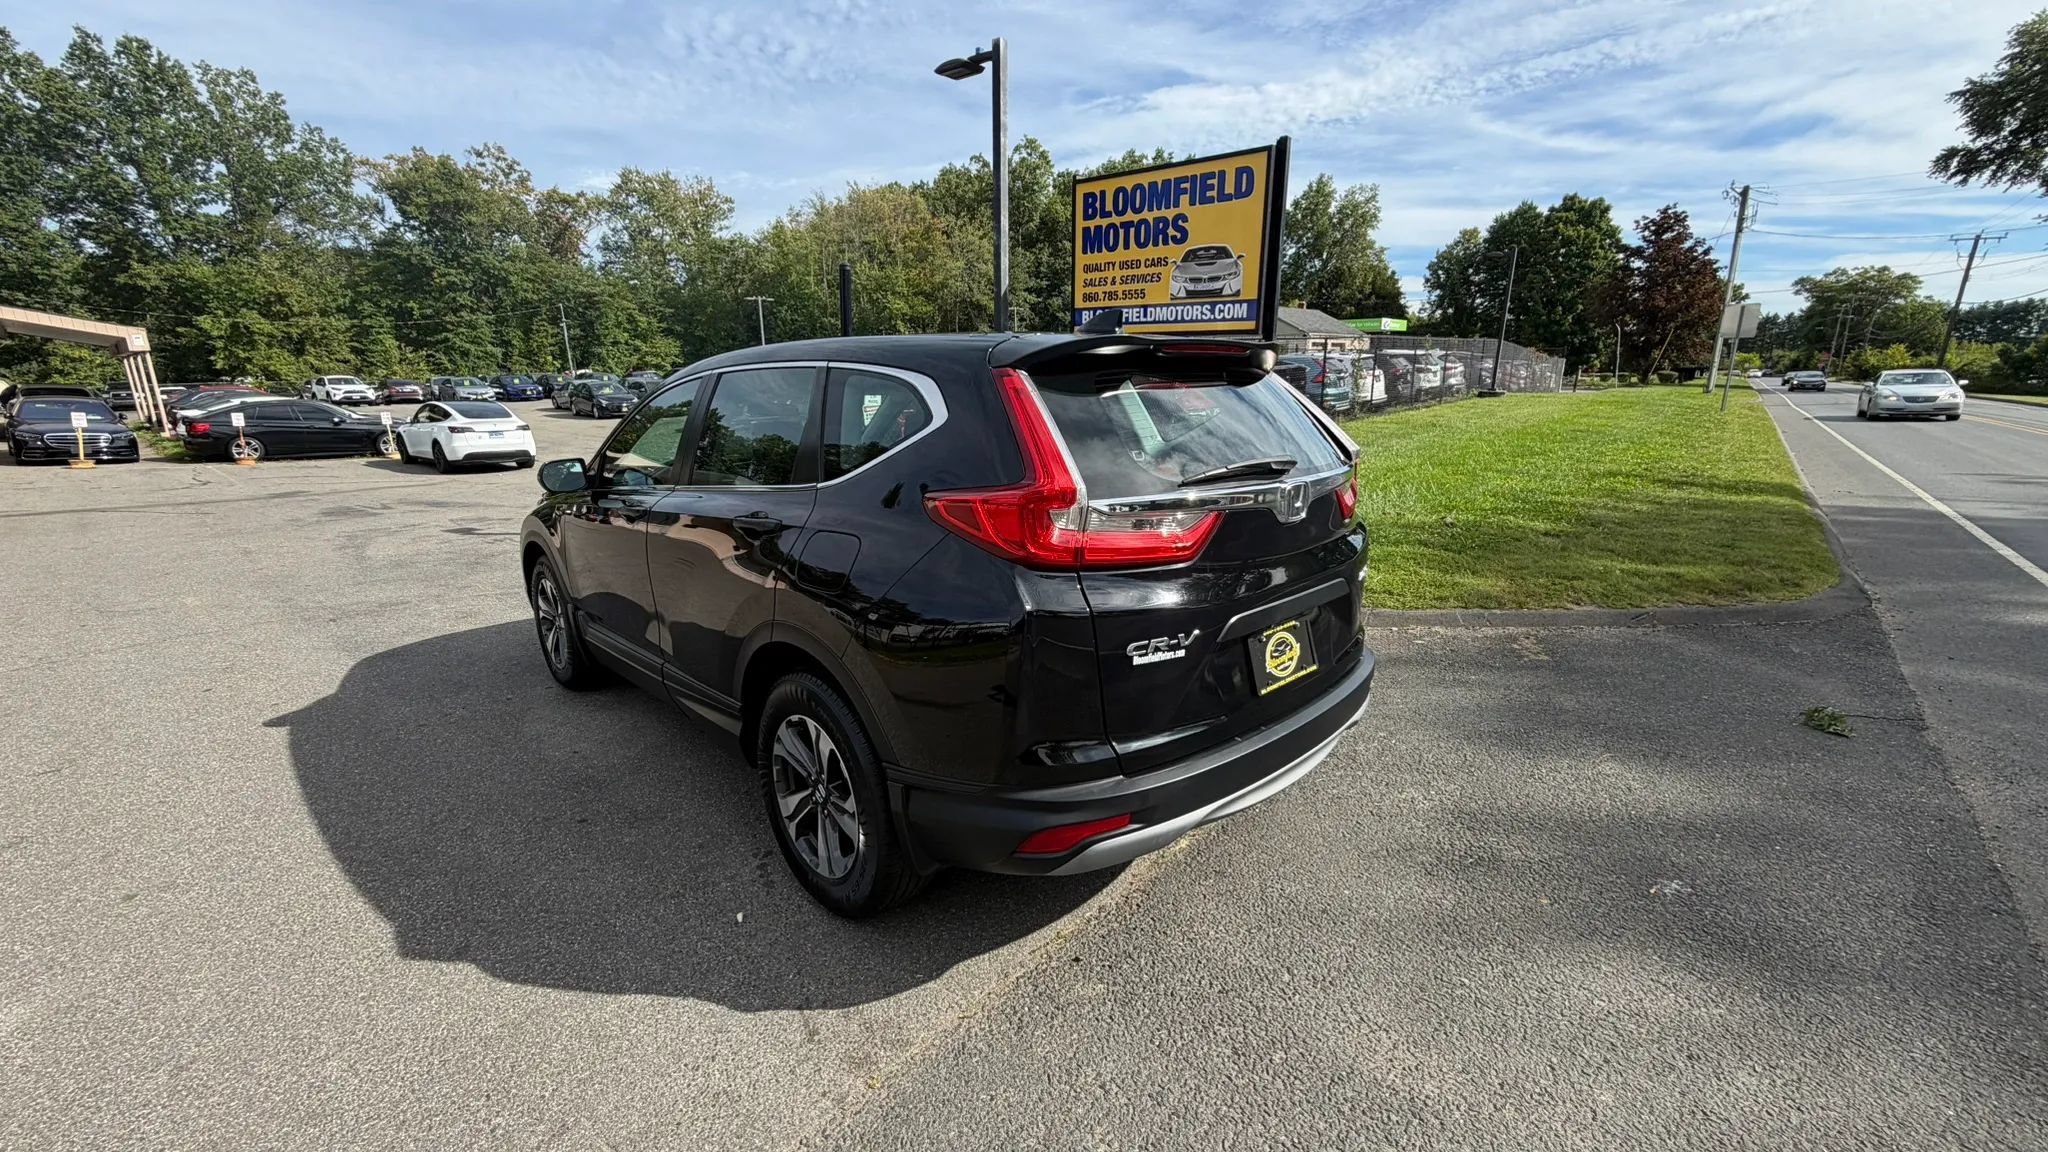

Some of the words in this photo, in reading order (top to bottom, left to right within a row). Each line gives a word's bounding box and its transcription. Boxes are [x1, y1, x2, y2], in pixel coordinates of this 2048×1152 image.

[1082, 166, 1255, 222] BLOOMFIELD
[1081, 213, 1190, 255] MOTORS
[1083, 261, 1116, 275] QUALITY
[1119, 259, 1141, 271] USED
[1144, 256, 1169, 268] CARS
[1082, 276, 1108, 288] SALES
[1110, 276, 1117, 286] &
[1119, 272, 1162, 285] SERVICES
[1082, 288, 1146, 303] 860.785.5555
[1081, 302, 1248, 323] BLFIELDMOTORS.COM
[1126, 629, 1200, 656] CR-V
